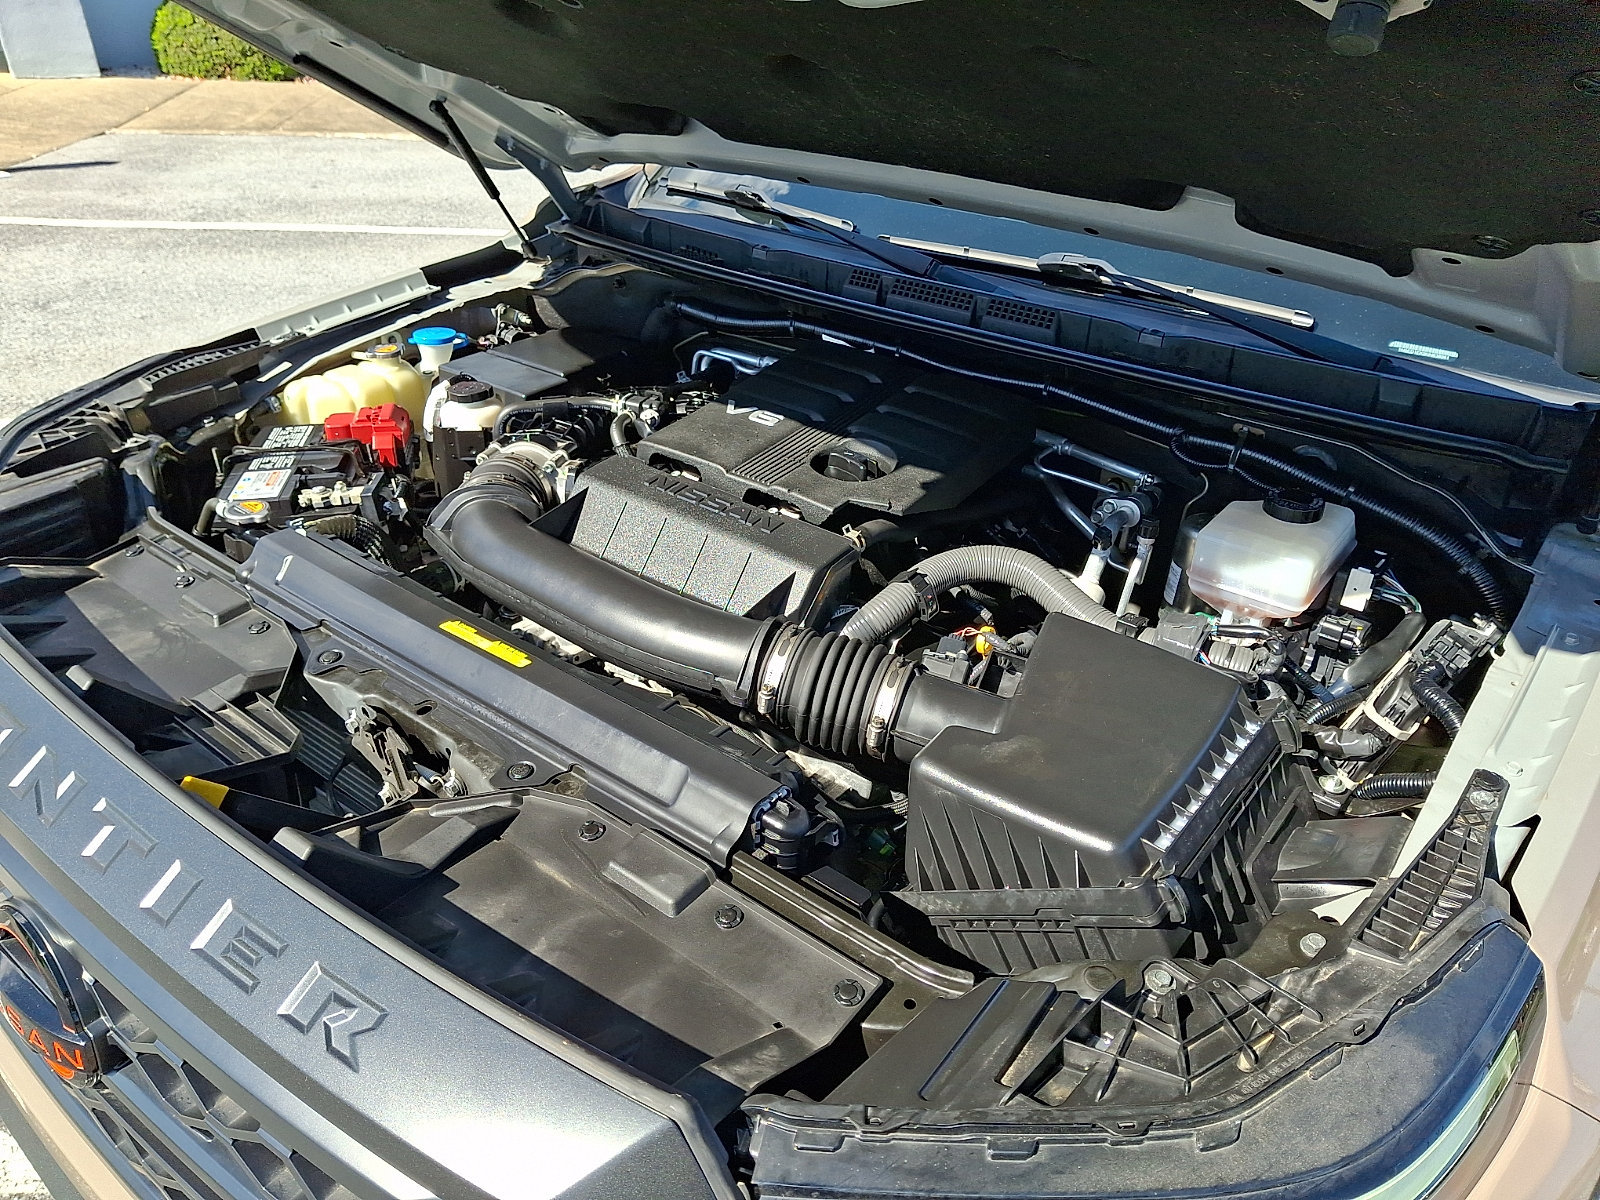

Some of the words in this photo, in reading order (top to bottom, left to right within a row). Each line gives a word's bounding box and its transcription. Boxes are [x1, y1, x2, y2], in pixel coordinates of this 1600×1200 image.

[726, 399, 785, 428] V6
[644, 477, 785, 534] NISSAN
[0, 1004, 85, 1070] SAN
